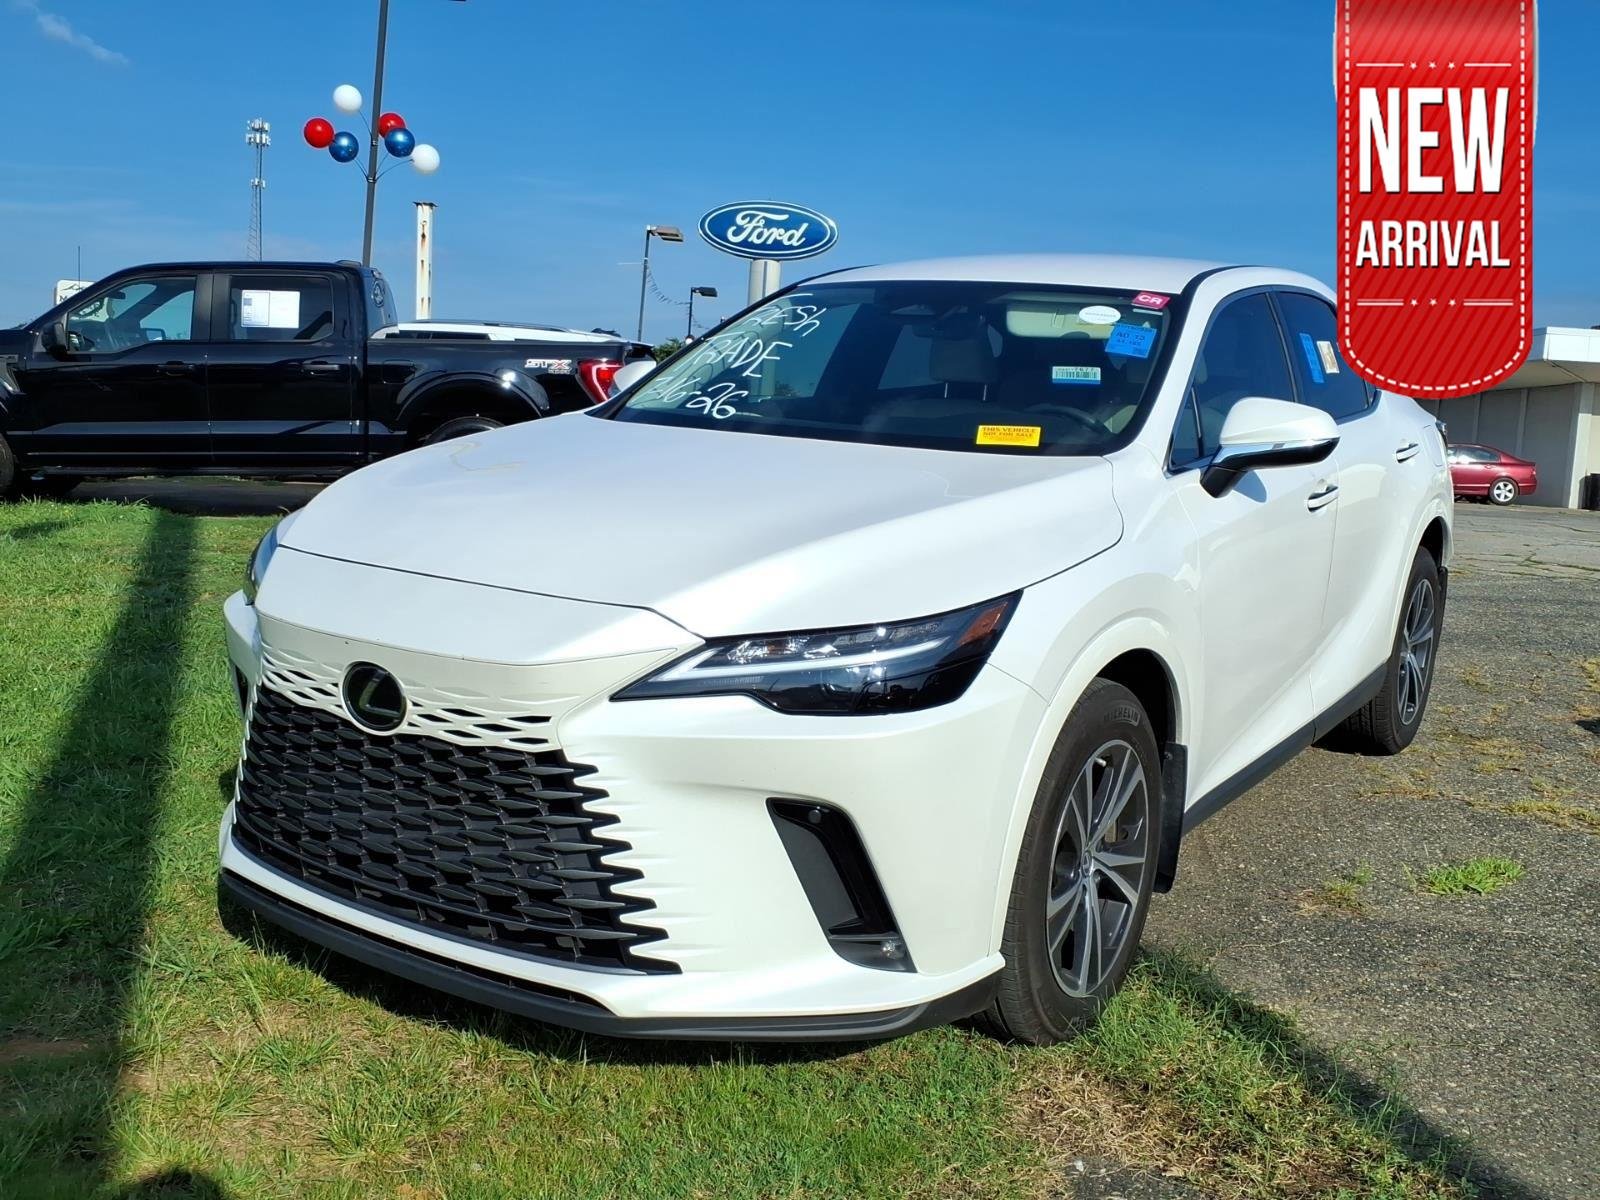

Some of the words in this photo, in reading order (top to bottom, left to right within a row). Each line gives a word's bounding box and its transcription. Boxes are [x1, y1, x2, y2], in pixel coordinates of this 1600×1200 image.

[727, 210, 808, 246] Ford
[1138, 294, 1163, 305] CR
[524, 358, 572, 369] STX
[673, 331, 793, 378] TRADE
